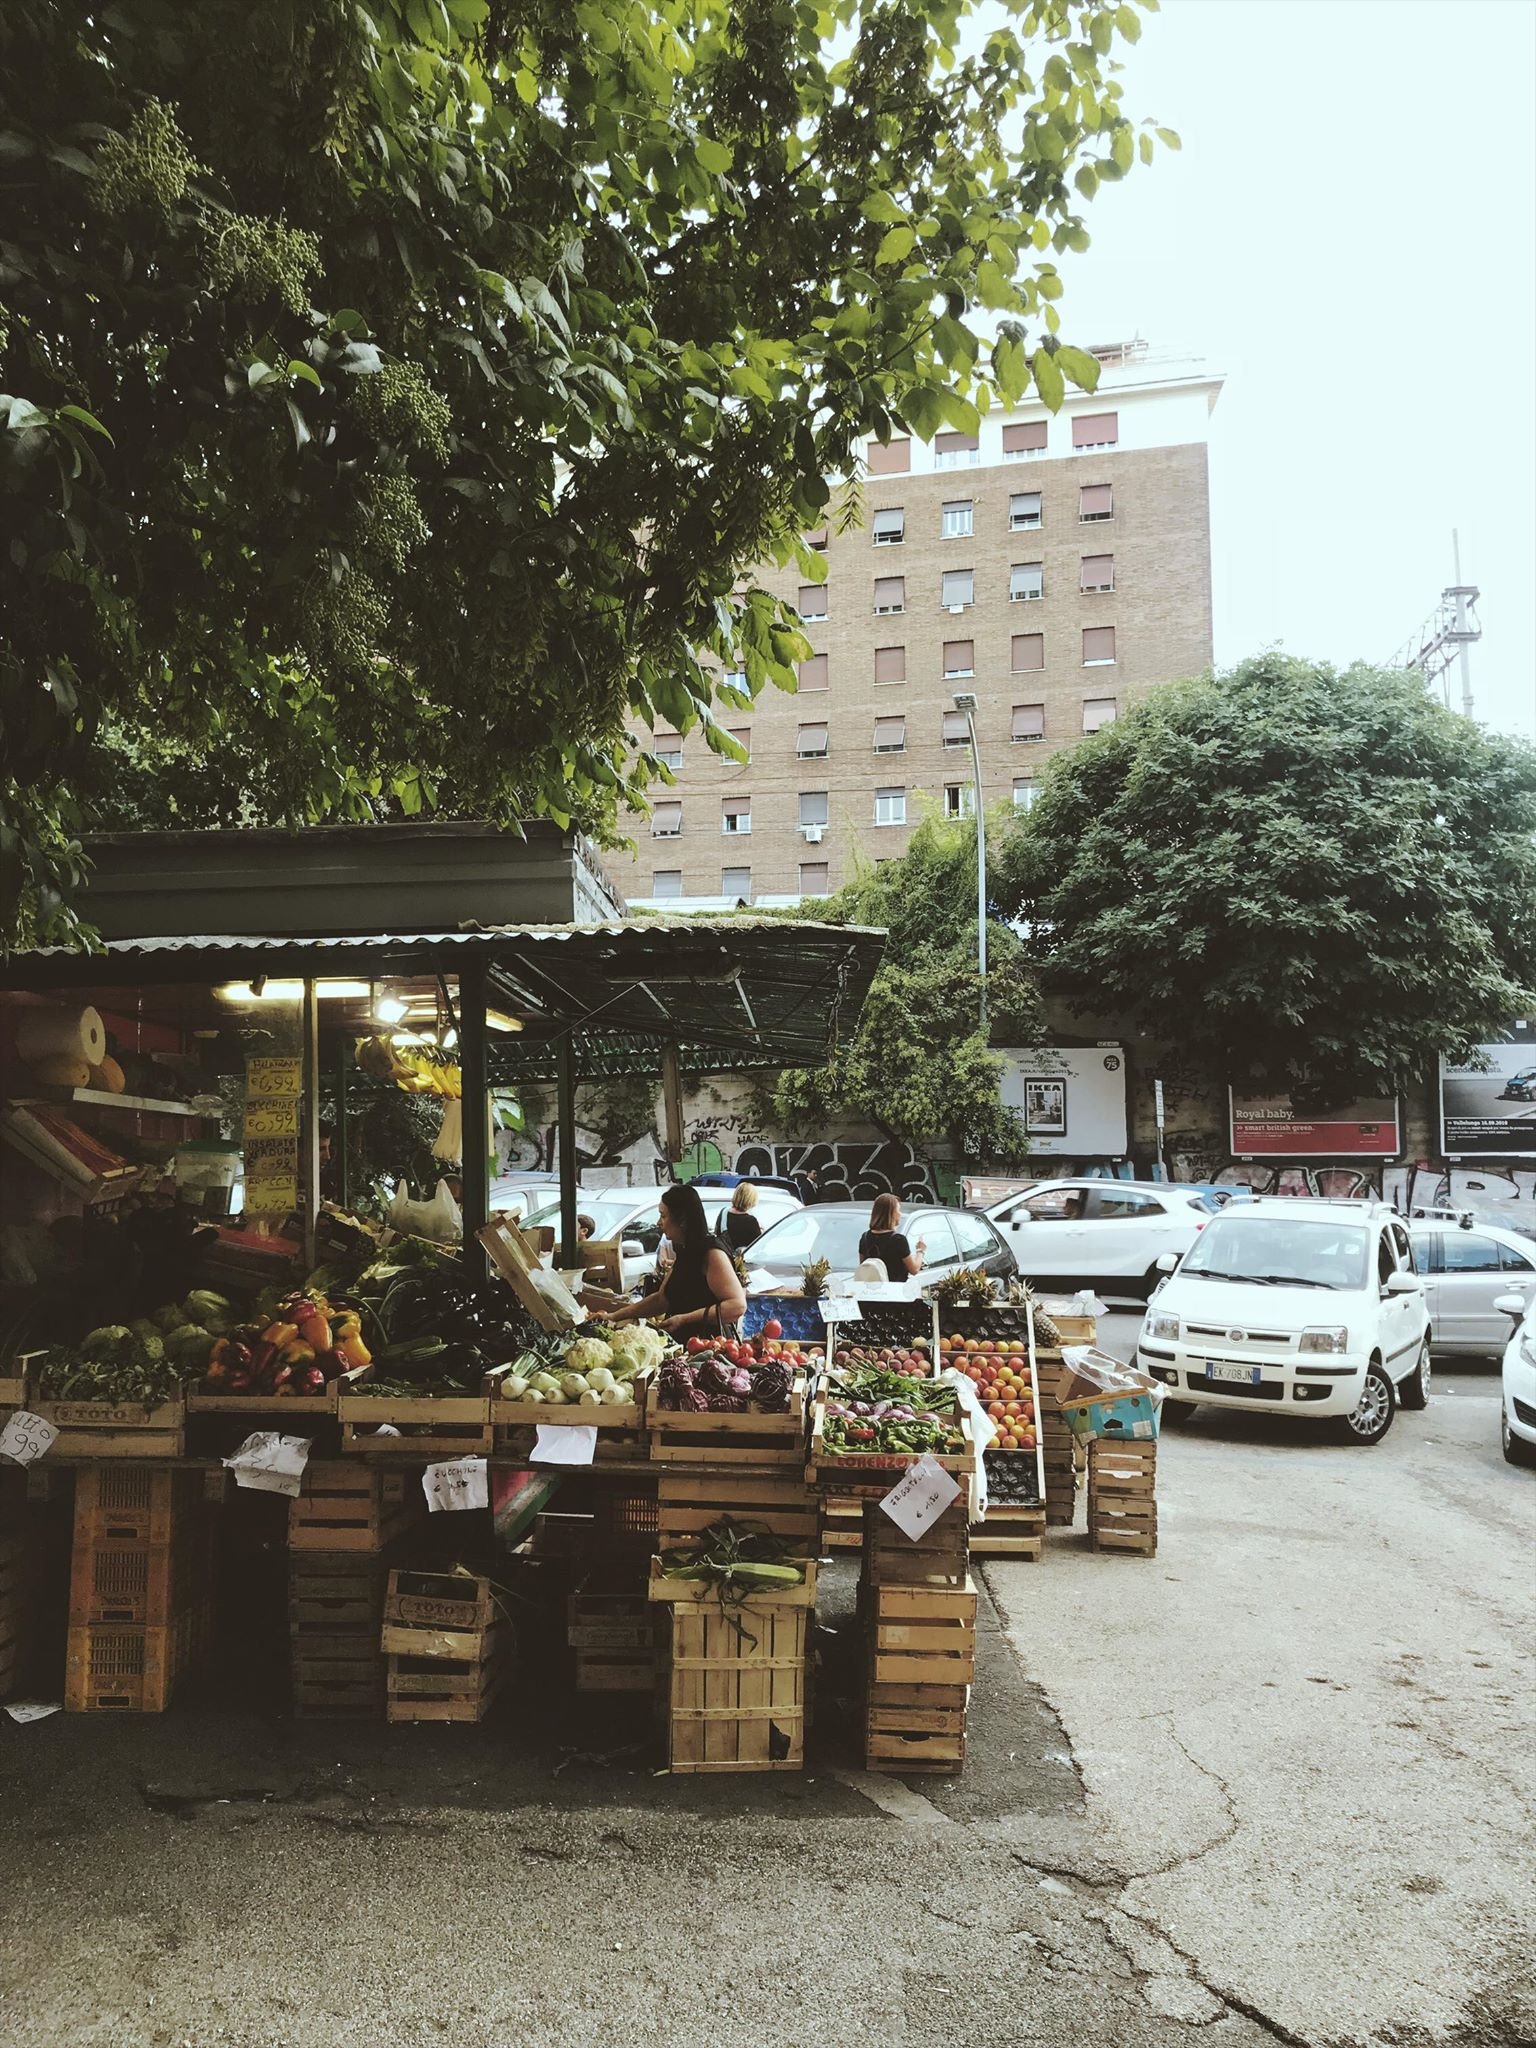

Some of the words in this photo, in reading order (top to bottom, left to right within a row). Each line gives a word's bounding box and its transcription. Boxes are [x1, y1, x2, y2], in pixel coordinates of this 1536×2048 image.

[1028, 1084, 1061, 1092] IKEA
[1236, 1110, 1264, 1120] Royal
[1267, 1109, 1295, 1120] baby.
[837, 1456, 908, 1468] LORENZO
